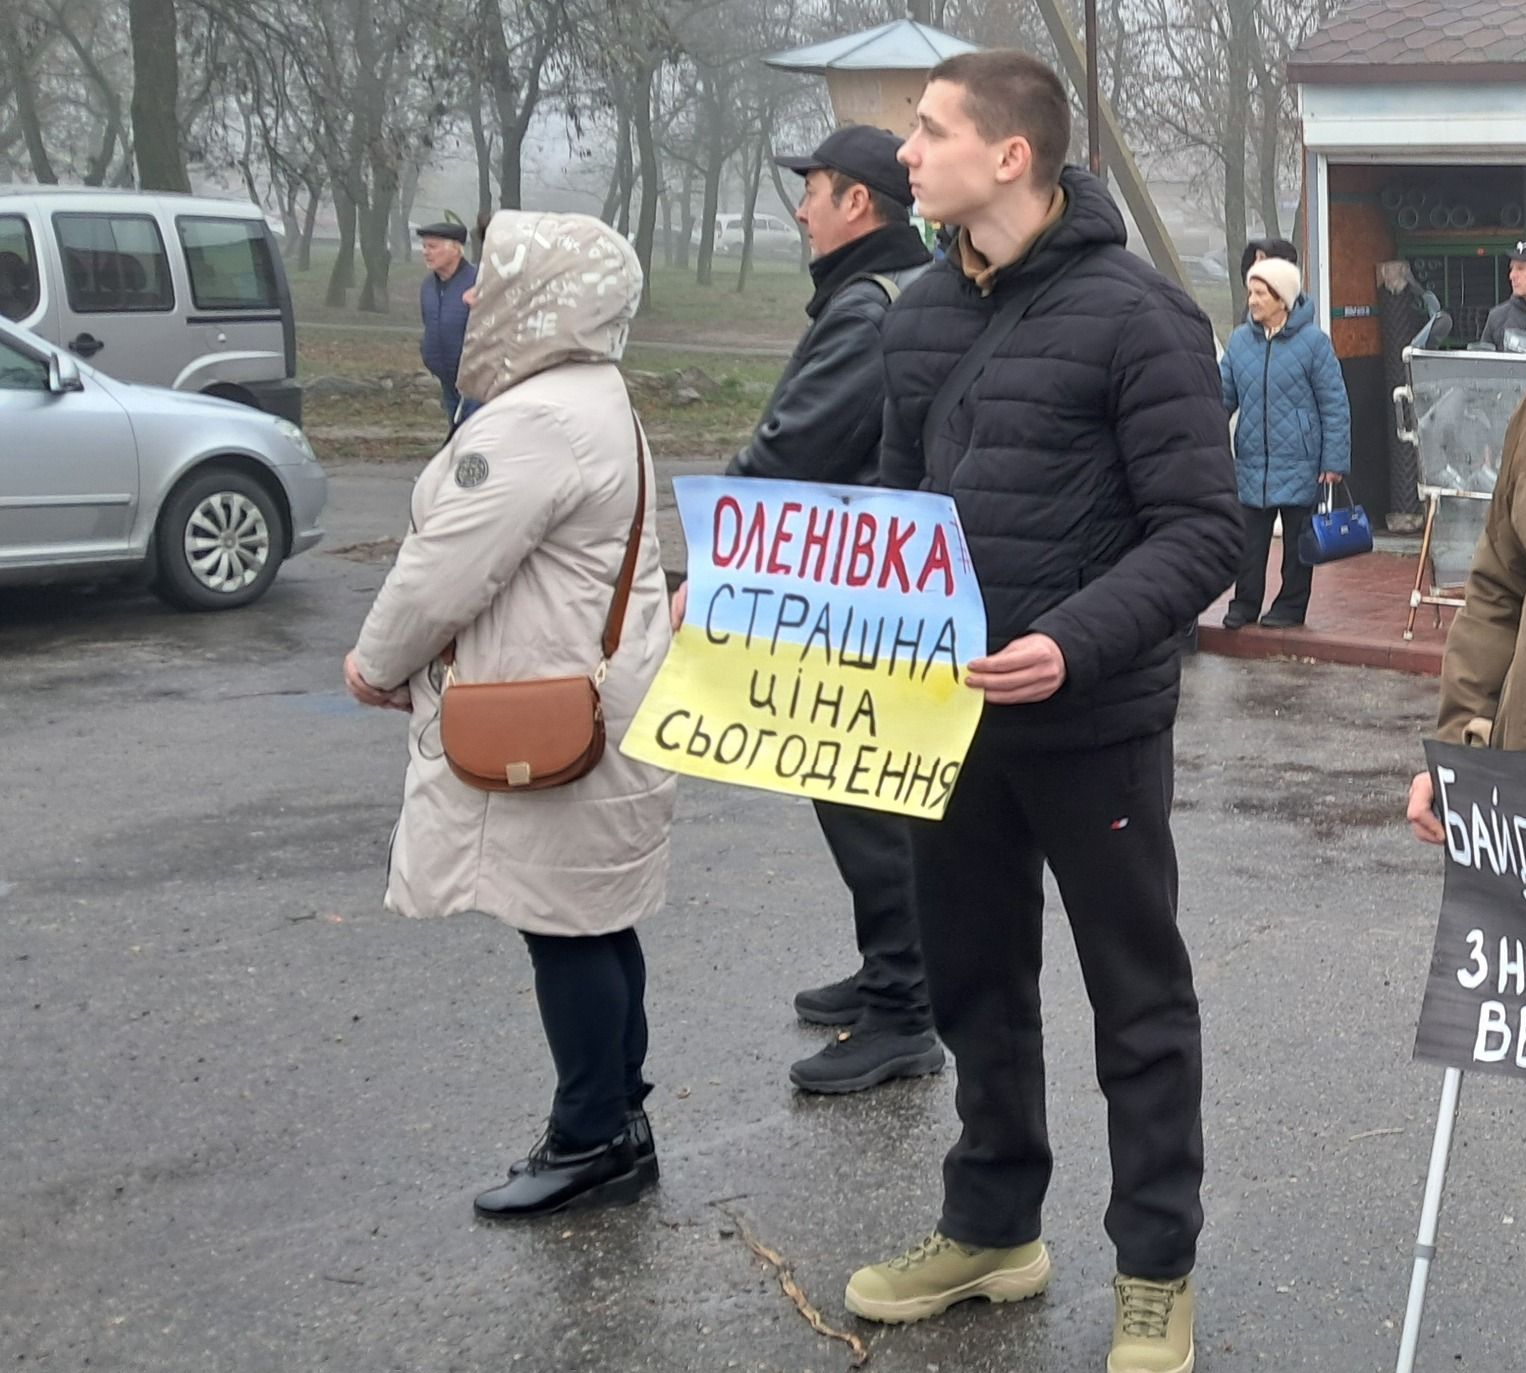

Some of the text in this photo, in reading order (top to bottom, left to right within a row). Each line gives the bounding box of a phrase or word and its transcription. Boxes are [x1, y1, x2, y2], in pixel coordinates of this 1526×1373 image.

[711, 495, 954, 596] ОЛЕНІВКА
[705, 583, 960, 684] СТРАШНА
[749, 667, 877, 737] ЦІНА
[655, 709, 961, 809] СЬОГОДЕННЯ
